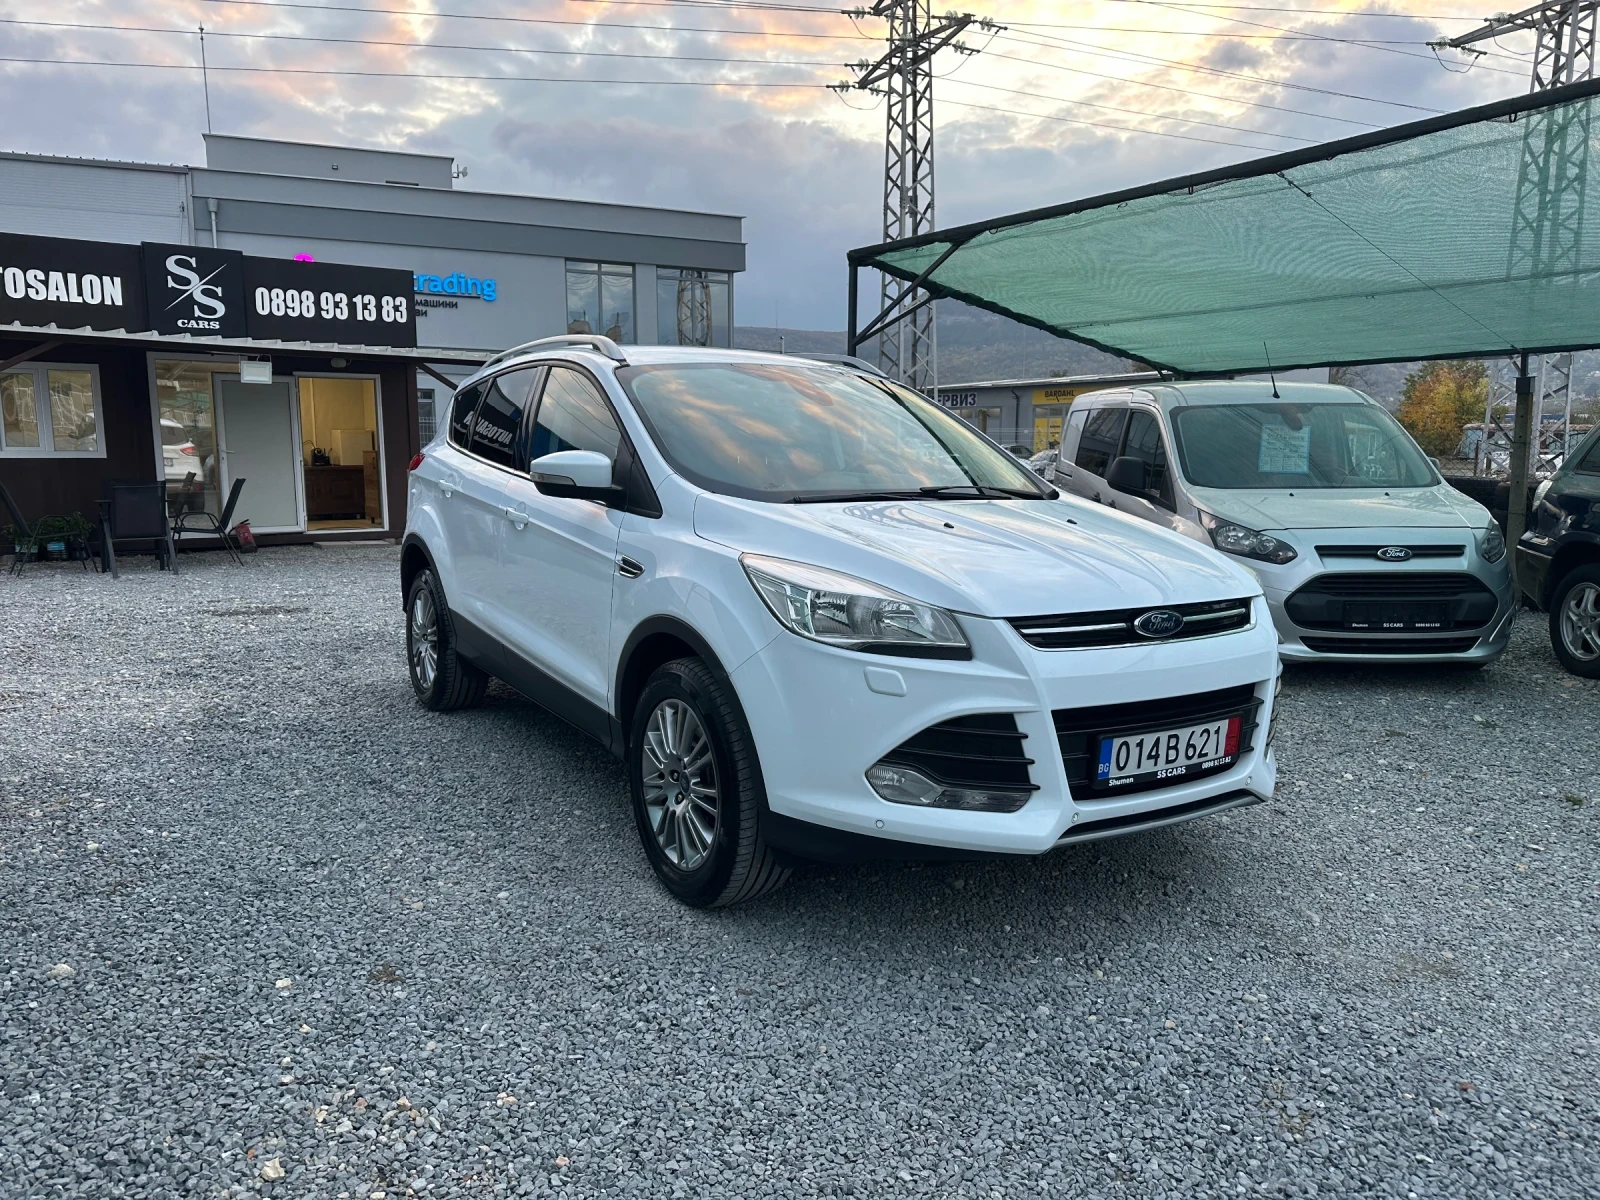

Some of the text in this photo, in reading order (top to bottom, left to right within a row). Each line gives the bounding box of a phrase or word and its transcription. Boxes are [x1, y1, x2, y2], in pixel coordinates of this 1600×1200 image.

[0, 266, 123, 306] OSALON
[255, 287, 408, 323] 0898 93 13 83
[177, 319, 220, 329] CARS
[1044, 389, 1075, 400] BARDAHL
[1386, 548, 1406, 557] Ford
[1149, 614, 1176, 631] Ford
[1098, 763, 1110, 773] BG
[1108, 776, 1134, 787] Shumen
[1157, 769, 1167, 779] SS
[1167, 766, 1186, 777] CARS
